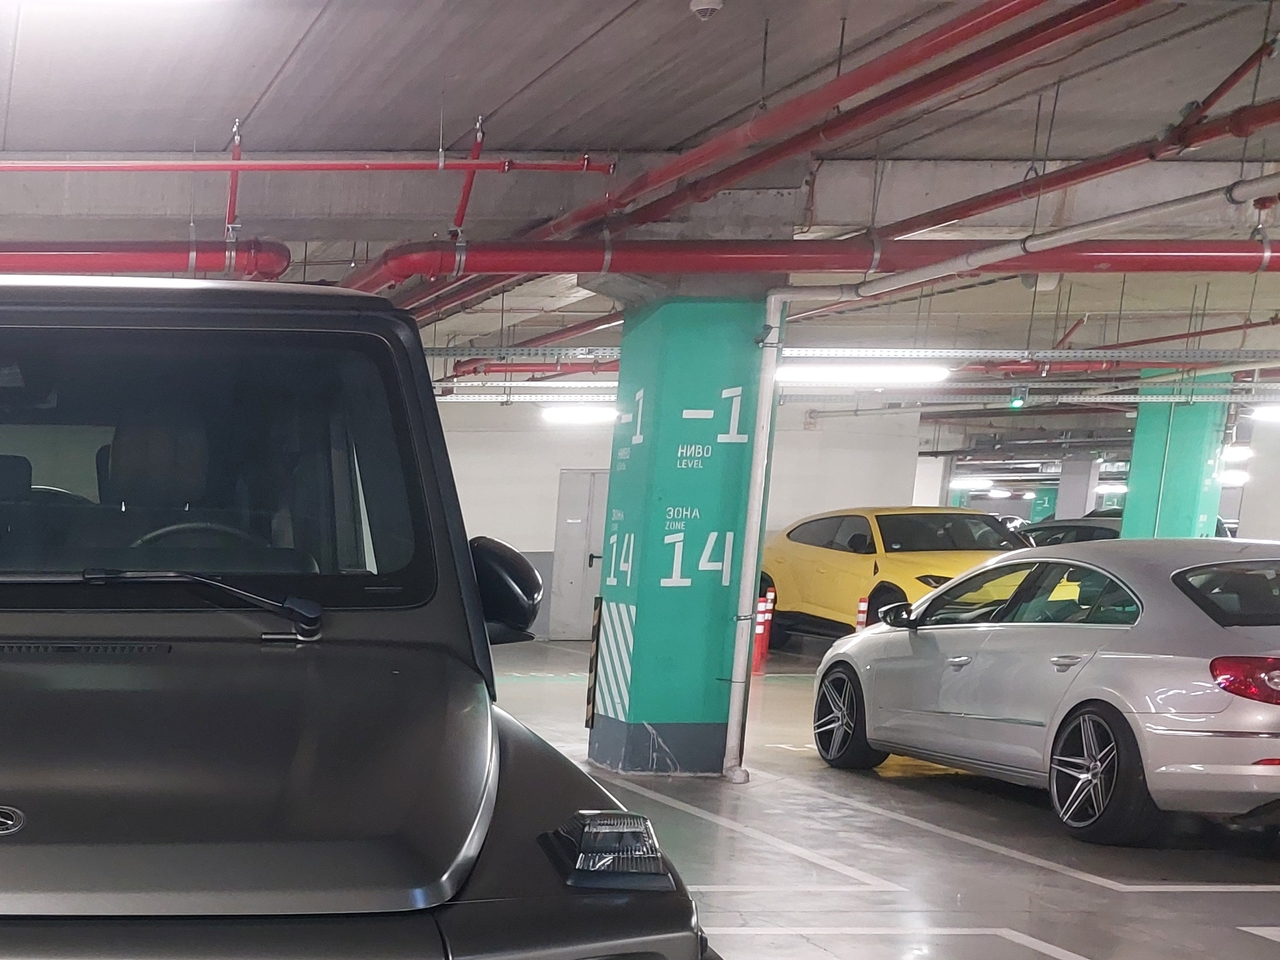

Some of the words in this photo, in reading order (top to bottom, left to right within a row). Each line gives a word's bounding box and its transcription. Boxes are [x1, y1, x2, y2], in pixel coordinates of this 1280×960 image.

[682, 386, 748, 443] -1
[677, 444, 712, 458] НИВО
[677, 460, 704, 469] LEVEL
[665, 507, 700, 520] ЗОНА
[665, 521, 686, 530] ZONE
[606, 533, 635, 587] 14
[660, 531, 734, 587] 14
